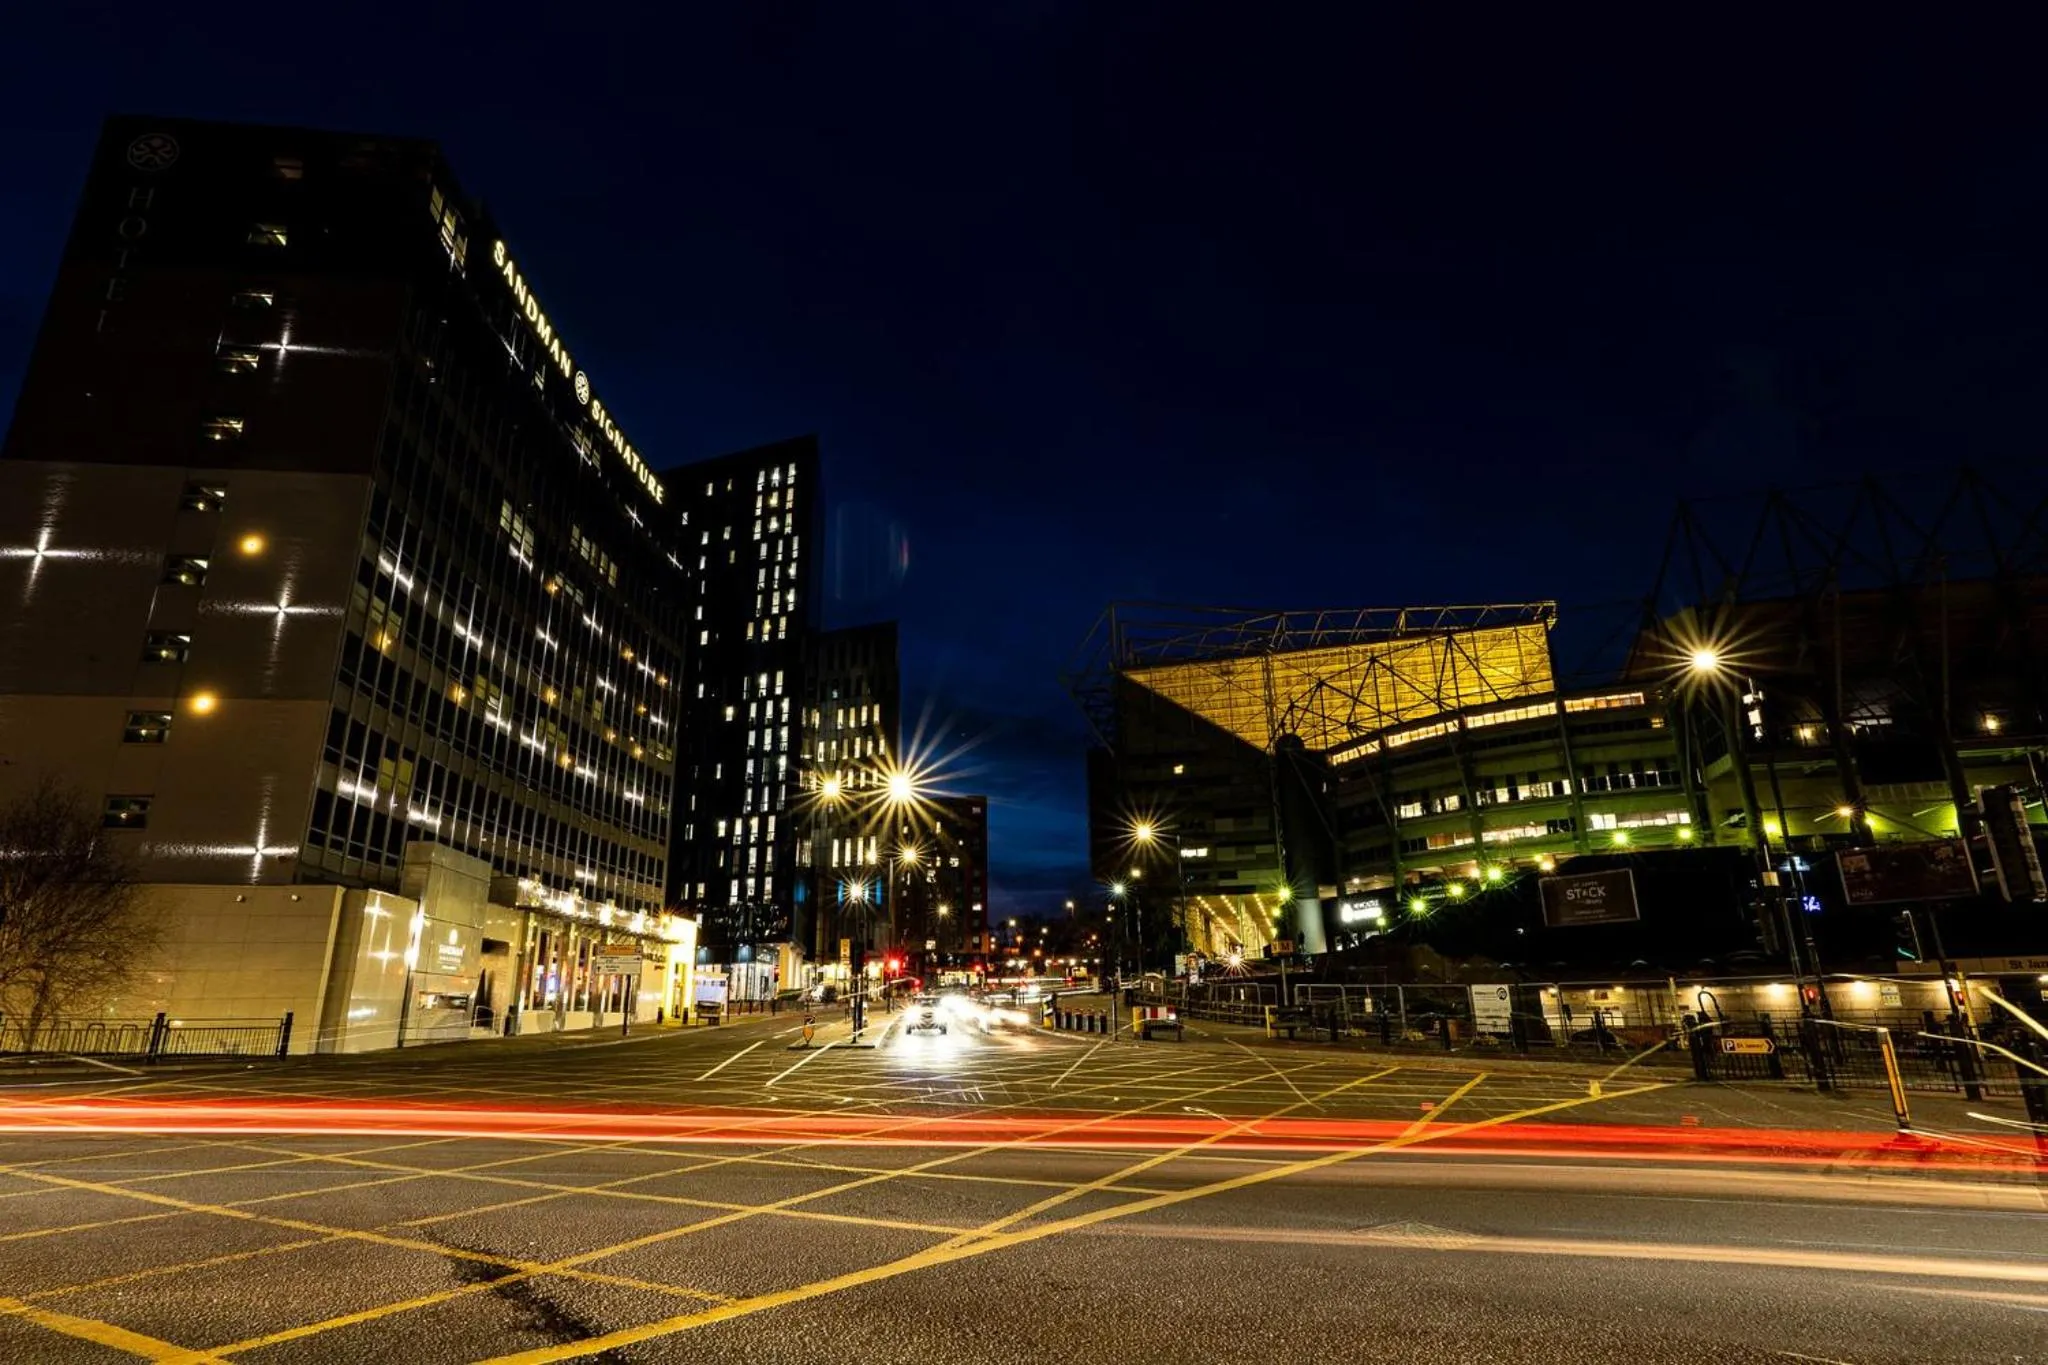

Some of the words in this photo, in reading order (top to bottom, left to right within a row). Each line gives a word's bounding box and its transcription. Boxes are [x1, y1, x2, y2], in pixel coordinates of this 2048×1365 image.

[96, 186, 155, 335] HOTEL
[492, 239, 572, 379] SANDMAN
[590, 398, 664, 506] SIGNATURE
[1565, 886, 1607, 901] STACK
